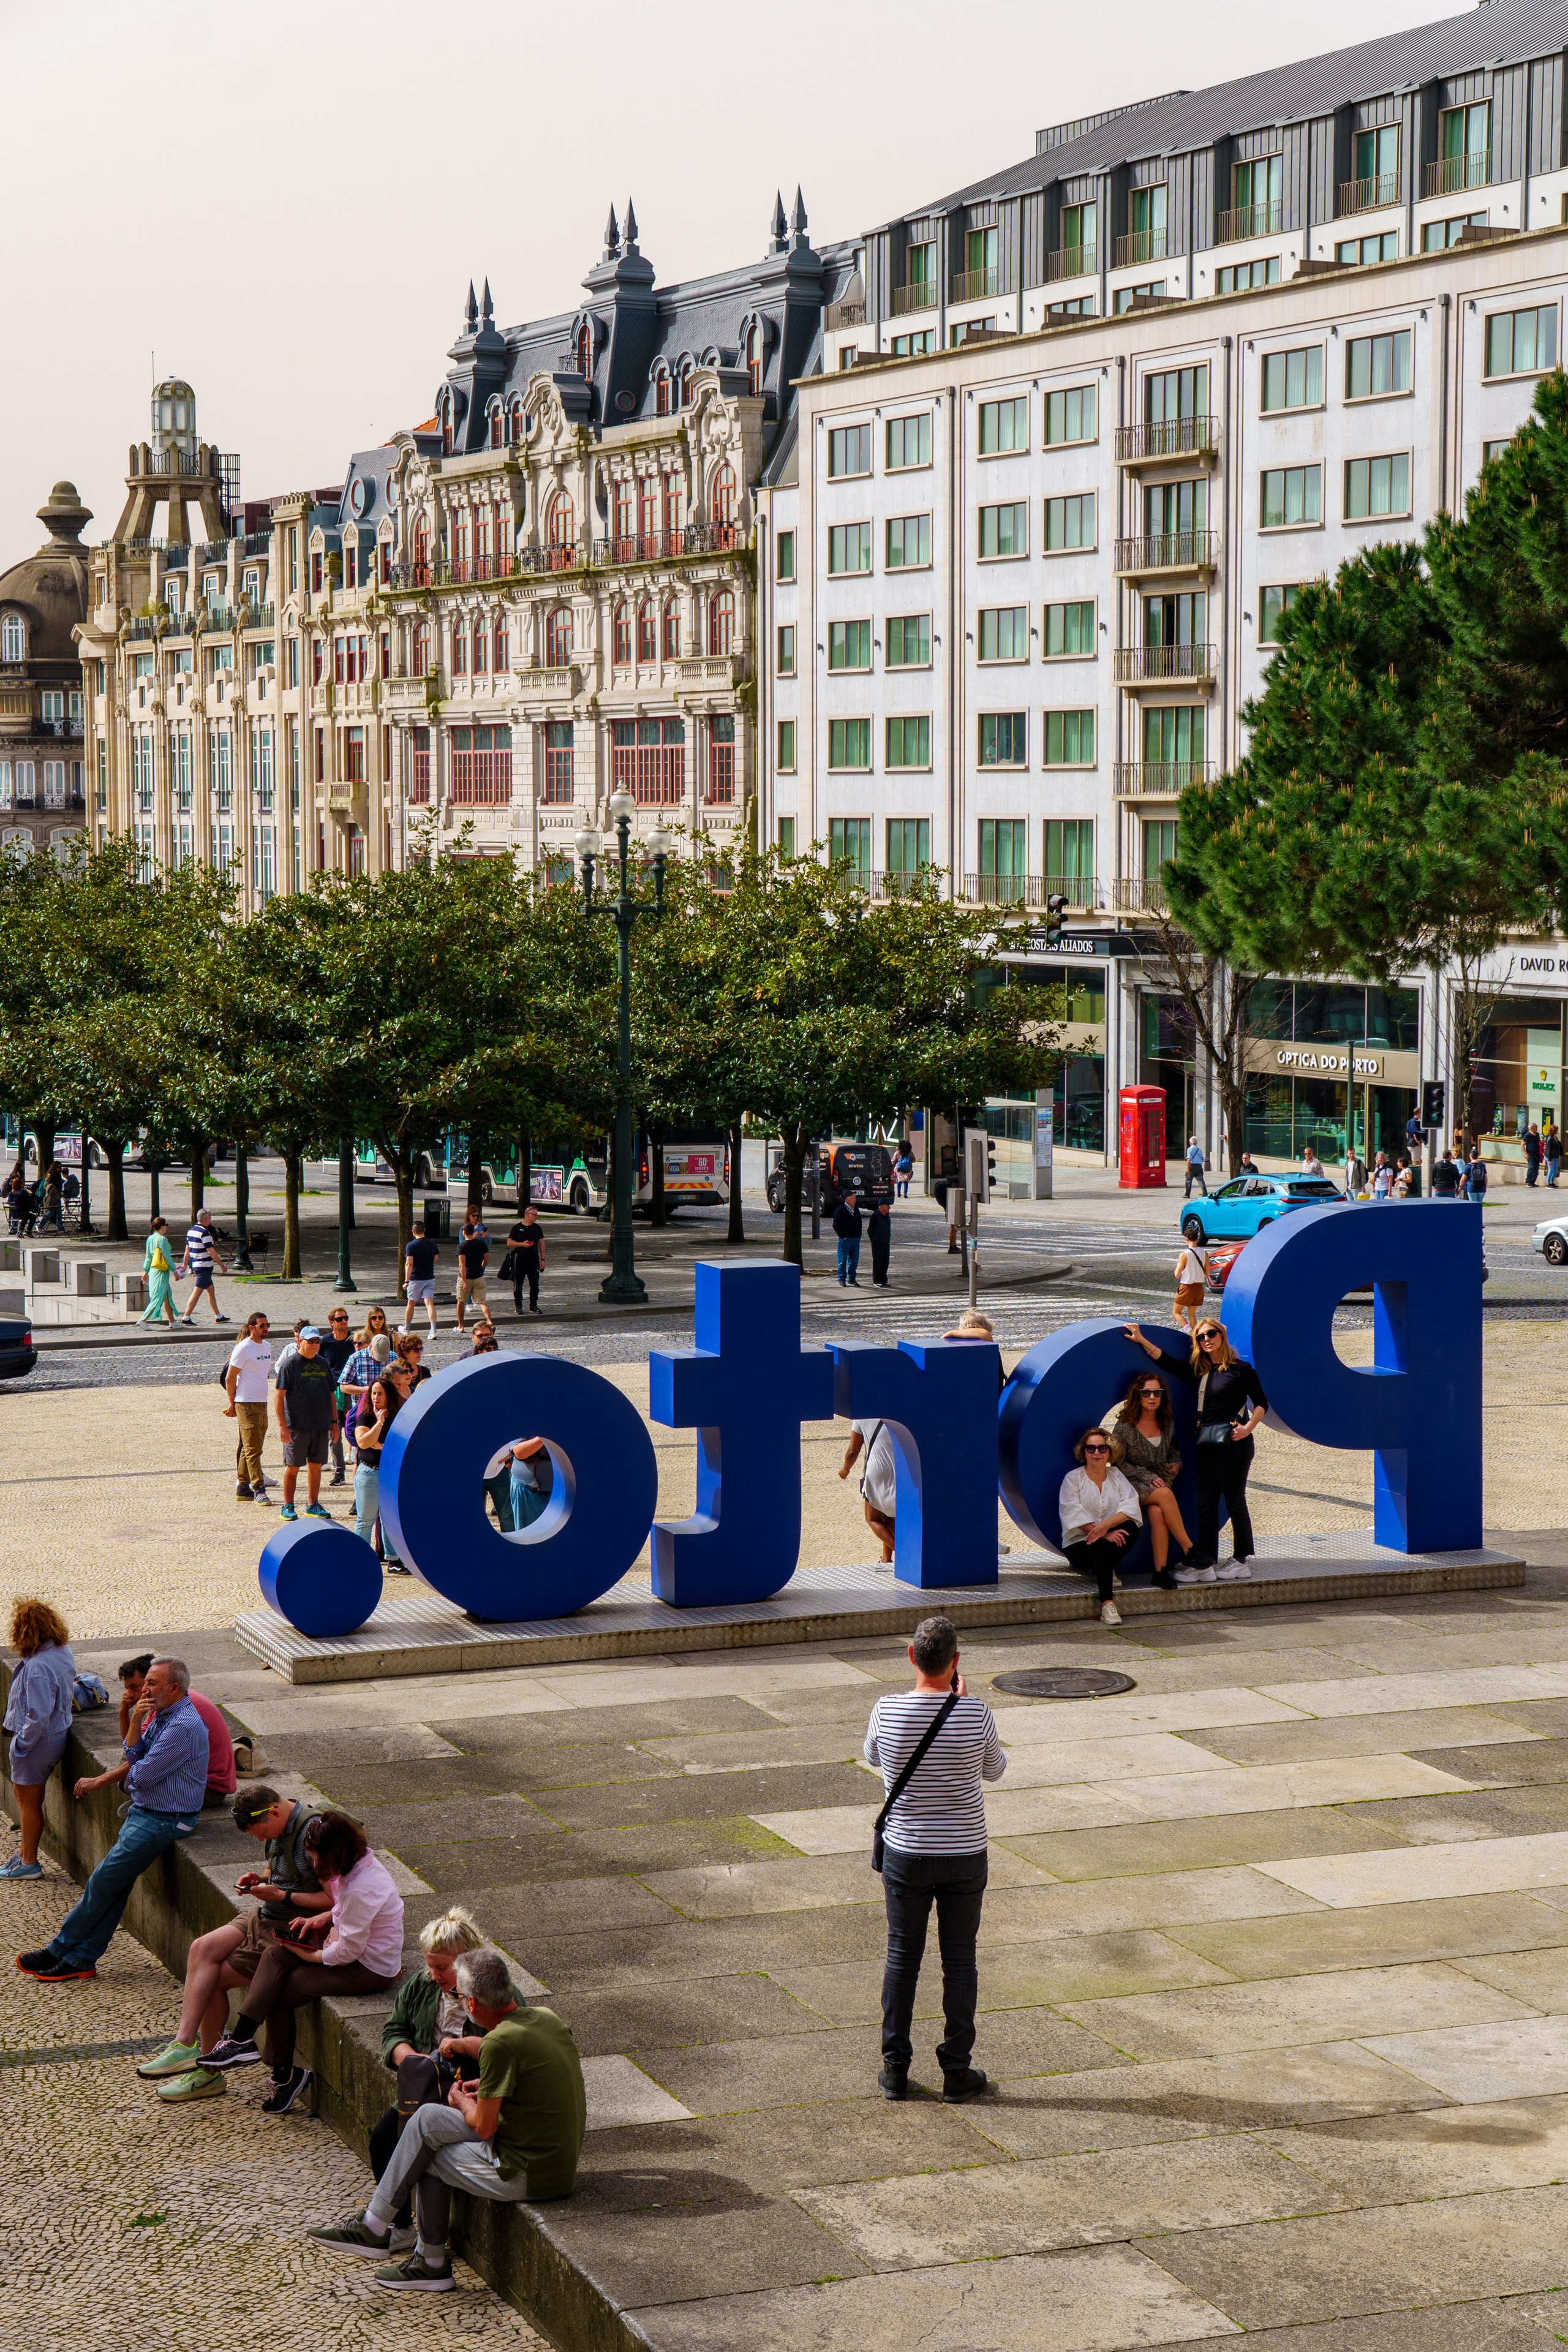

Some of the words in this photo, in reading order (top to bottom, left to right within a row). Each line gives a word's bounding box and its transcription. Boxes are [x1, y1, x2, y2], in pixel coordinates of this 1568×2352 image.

[1059, 940, 1093, 952] ALIADOS
[1521, 958, 1555, 972] DAVID
[1559, 959, 1568, 973] R
[1321, 1055, 1337, 1069] DO
[1532, 1082, 1555, 1091] ROLEX
